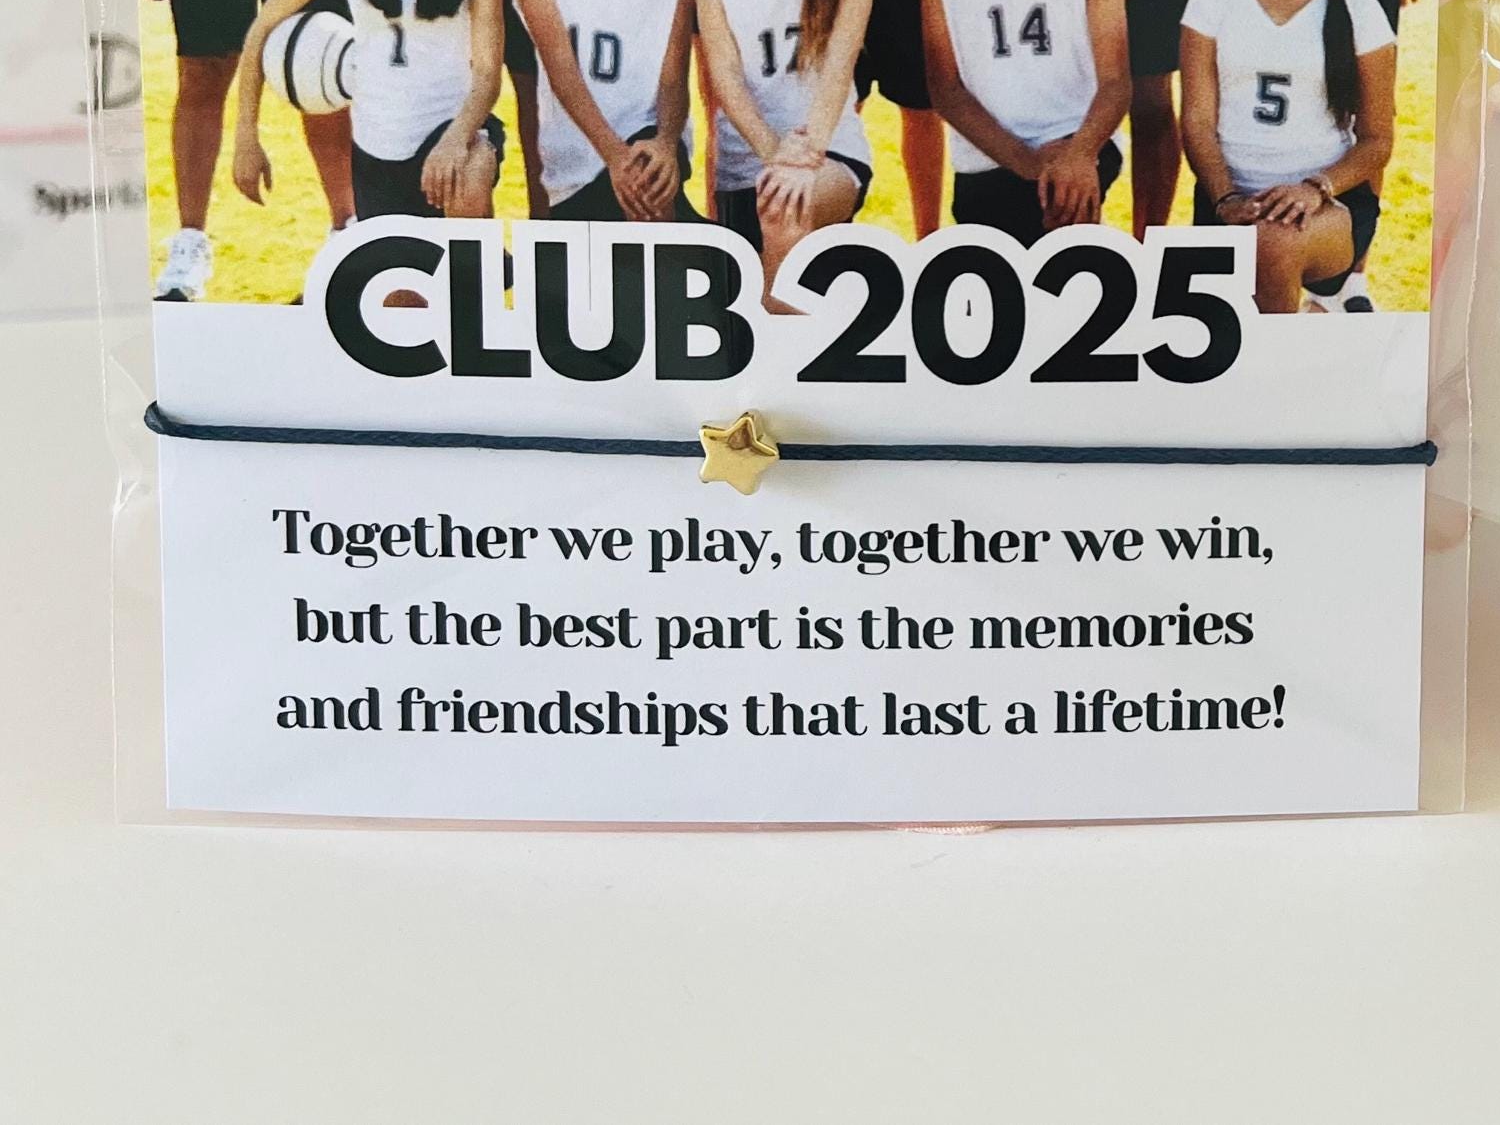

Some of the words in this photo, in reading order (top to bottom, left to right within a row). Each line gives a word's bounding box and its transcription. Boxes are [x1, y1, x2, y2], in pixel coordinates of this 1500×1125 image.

[987, 3, 1053, 59] 14
[1252, 71, 1292, 127] 5
[324, 236, 755, 382] CLUB
[796, 244, 1242, 386] 2025
[272, 509, 539, 569] Together
[547, 527, 633, 562] we
[647, 517, 782, 575] play,
[795, 519, 1051, 576] together
[1060, 528, 1144, 563] we
[1155, 515, 1273, 565] win,
[293, 597, 393, 645] but
[404, 601, 502, 647] the
[516, 602, 642, 649] best
[655, 609, 782, 661] part
[795, 606, 844, 650] is
[857, 606, 954, 650] the
[969, 602, 1254, 649] memories
[276, 686, 383, 732] and
[396, 686, 729, 747] friendships
[741, 691, 868, 737] that
[882, 692, 991, 736] last
[1004, 701, 1039, 735] a
[1053, 684, 1286, 734] lifetime!
